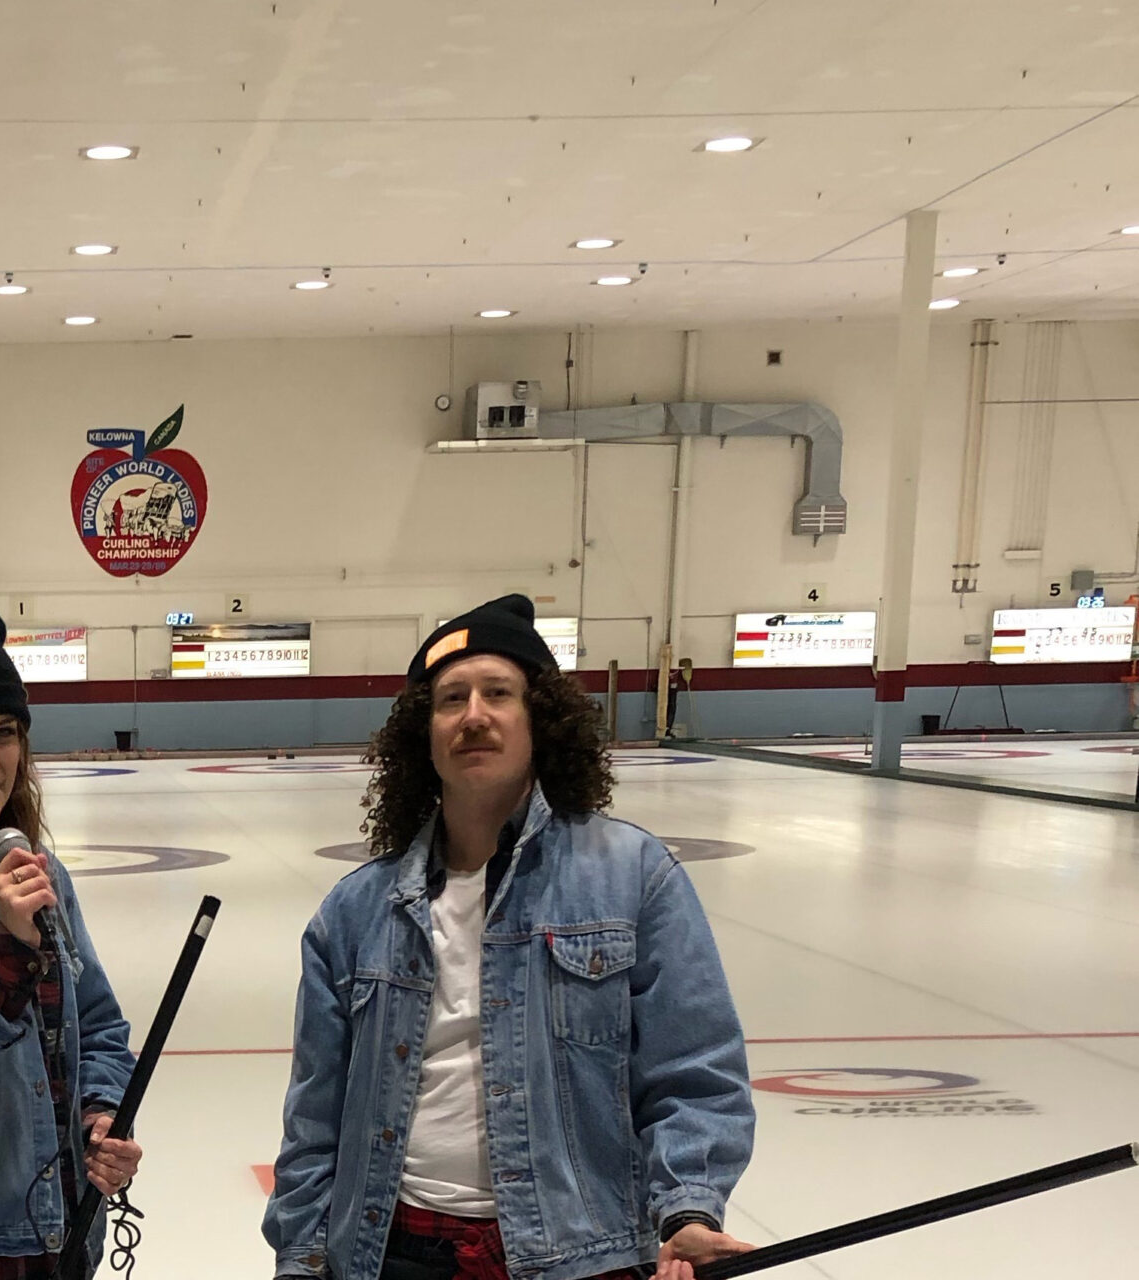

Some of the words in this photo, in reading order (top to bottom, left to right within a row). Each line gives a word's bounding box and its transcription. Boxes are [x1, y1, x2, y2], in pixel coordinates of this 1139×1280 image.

[88, 432, 135, 442] KELOWNA
[153, 419, 176, 446] CANADA
[83, 473, 114, 529] PIONEER
[115, 461, 165, 477] WORLD
[166, 473, 195, 519] LADIES
[102, 539, 150, 549] CURLING
[97, 549, 180, 560] CHAMPIONSHIP
[807, 589, 820, 602] 4
[1049, 583, 1061, 597] 5
[231, 599, 242, 613] 2
[283, 650, 291, 660] 10
[293, 650, 300, 660] 11
[301, 649, 309, 660] 12
[794, 1104, 1037, 1115] CURLING
